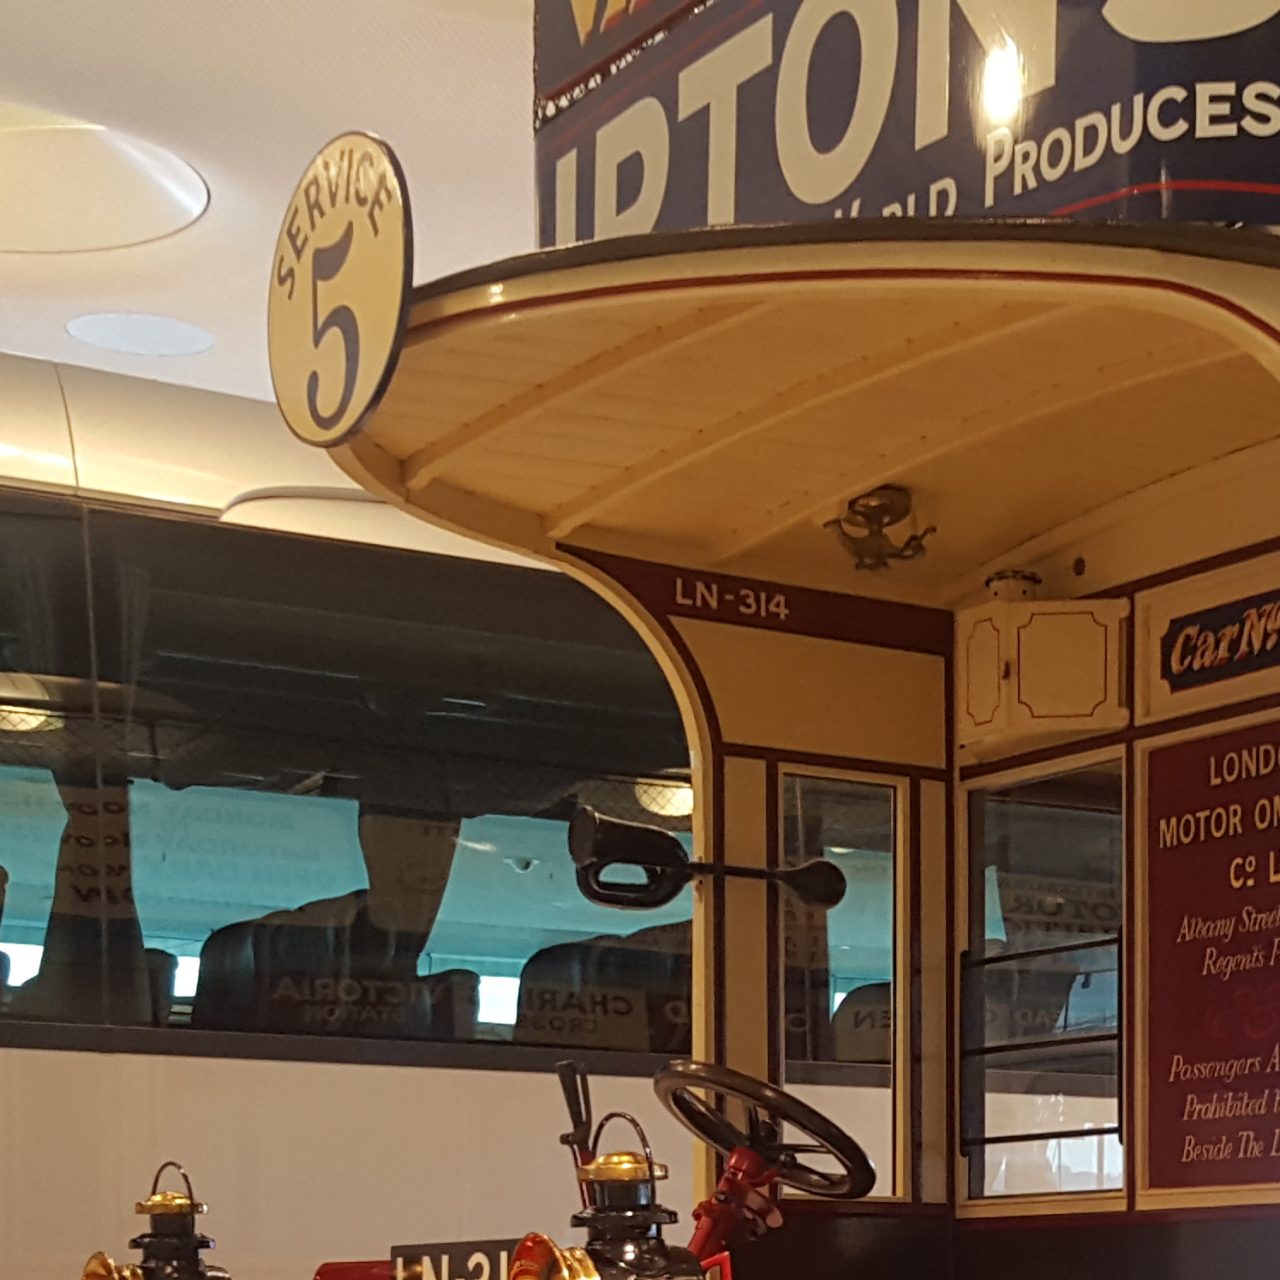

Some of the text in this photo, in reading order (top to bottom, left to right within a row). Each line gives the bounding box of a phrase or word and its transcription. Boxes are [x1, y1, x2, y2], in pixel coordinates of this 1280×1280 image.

[555, 0, 1057, 247] IPTON
[275, 148, 394, 300] SERVICE
[306, 219, 360, 431] 5
[674, 577, 789, 621] LN-314
[1170, 622, 1239, 675] Car
[1158, 803, 1244, 849] MOTOR
[1175, 915, 1237, 944] Albany
[1168, 1054, 1262, 1083] Passengers
[1183, 1088, 1270, 1121] Prohibited
[1181, 1135, 1234, 1163] Beside
[1236, 1130, 1266, 1159] The
